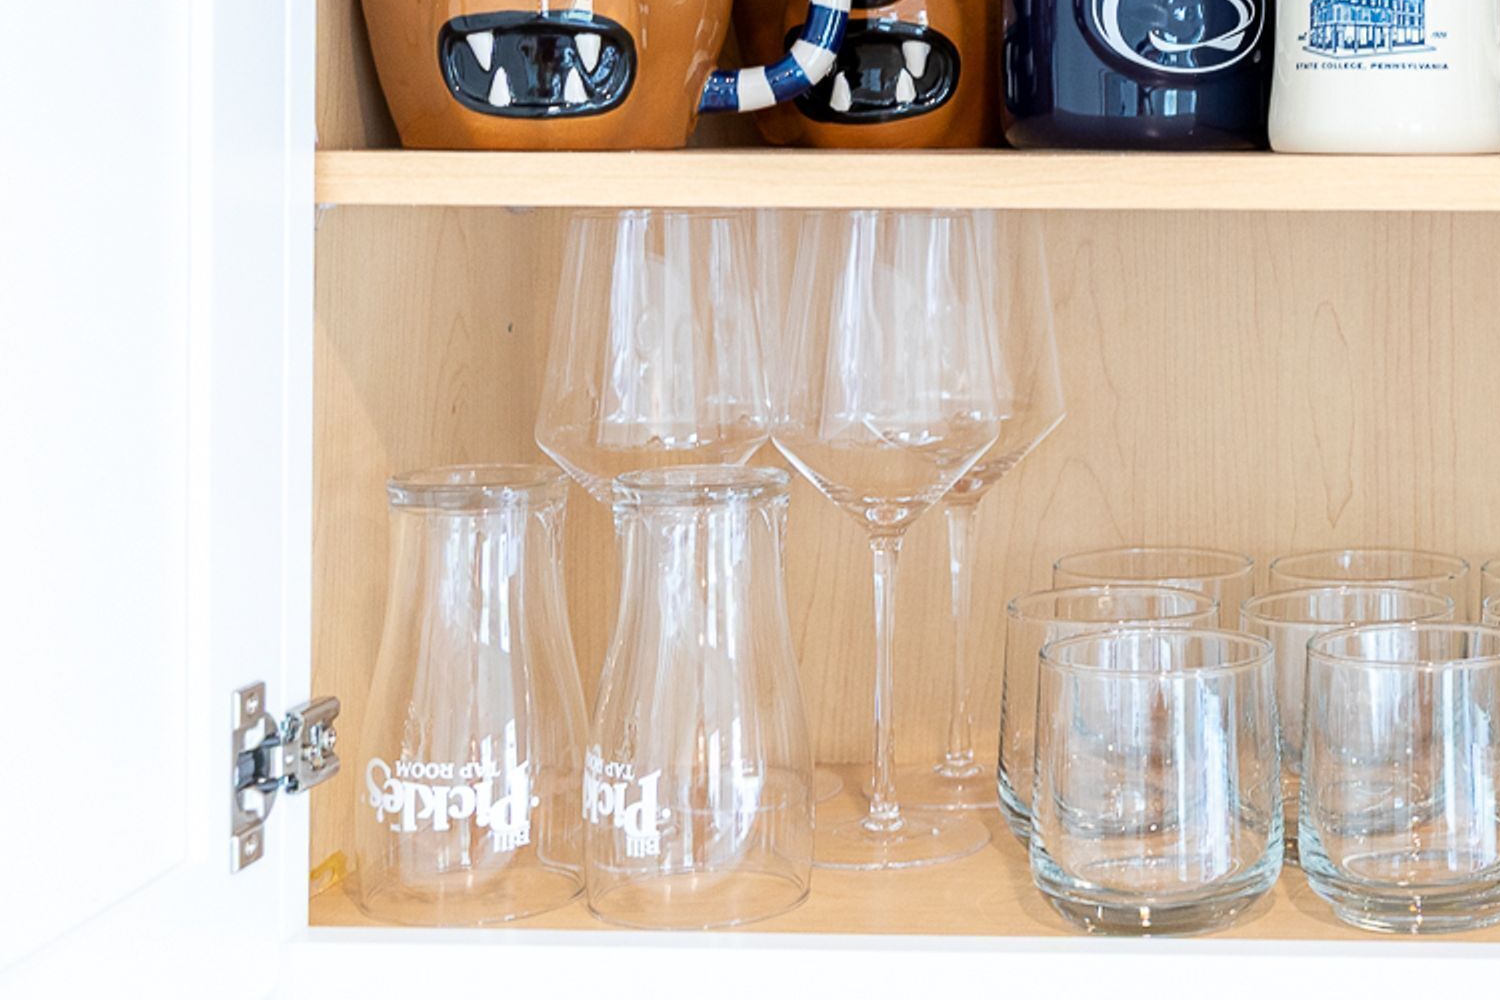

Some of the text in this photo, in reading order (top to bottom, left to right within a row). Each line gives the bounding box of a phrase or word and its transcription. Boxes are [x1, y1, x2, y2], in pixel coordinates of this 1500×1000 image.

[1370, 61, 1449, 71] PENNSYLVANIA
[394, 760, 502, 779] TAP ROOM
[604, 761, 636, 781] TAP
[625, 835, 661, 859] Bill
